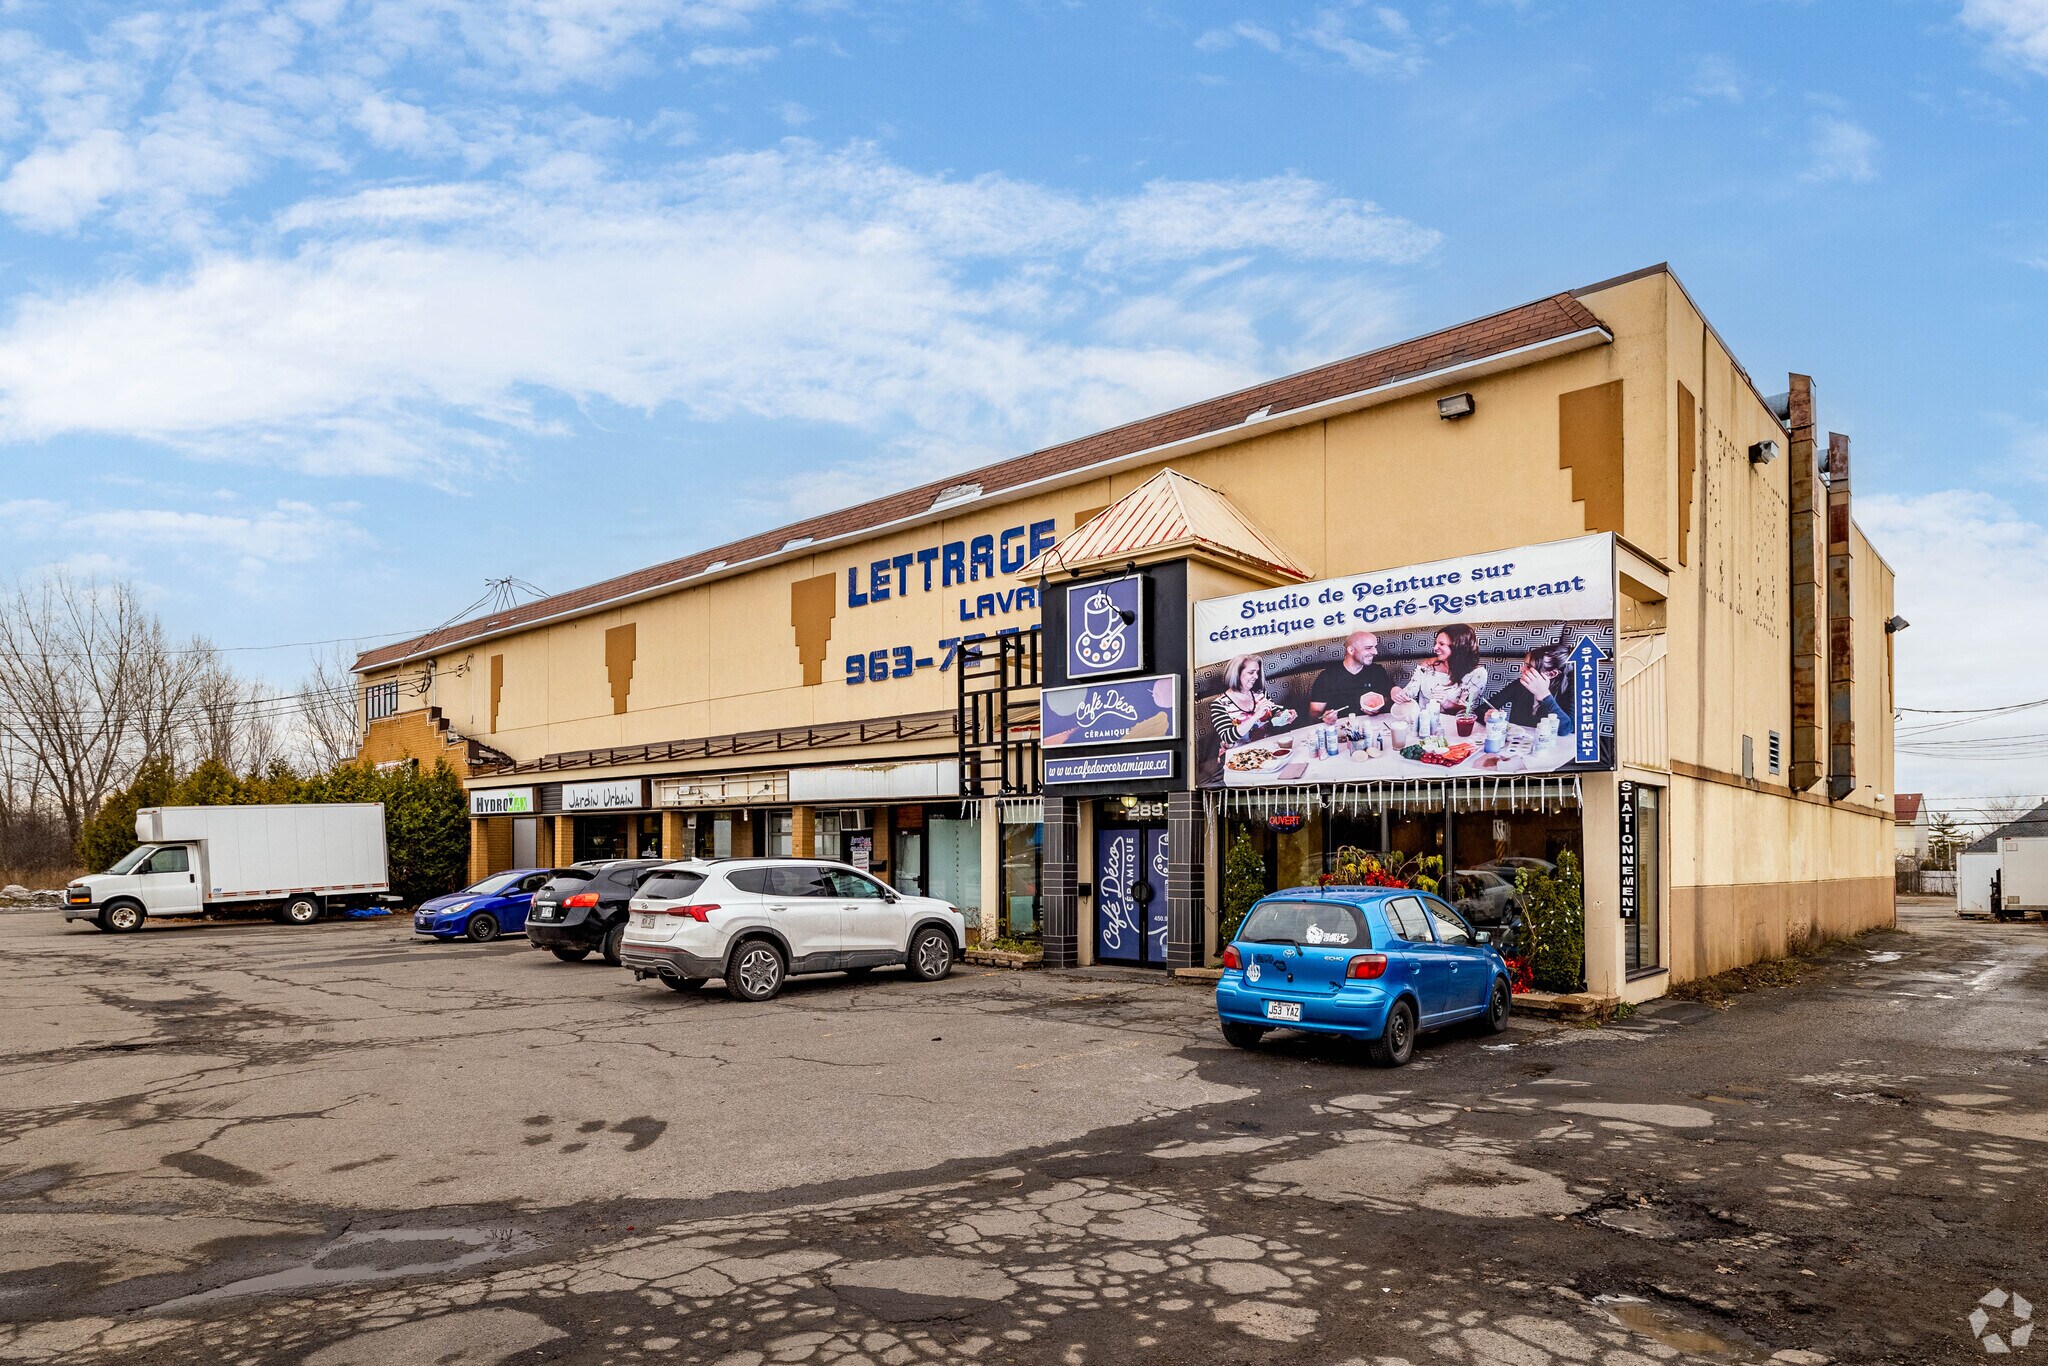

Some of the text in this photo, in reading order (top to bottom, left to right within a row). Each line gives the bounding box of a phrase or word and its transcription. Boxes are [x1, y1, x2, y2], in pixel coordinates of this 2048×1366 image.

[1209, 575, 1585, 642] céramique et Café-Restaurant
[1240, 562, 1514, 620] Studio de Peinture sur
[1076, 689, 1137, 720] Café Déco
[1580, 647, 1594, 756] STATIONNEMENT
[1084, 728, 1130, 738] CÉRAMIQUE
[1048, 756, 1168, 779] www.cafedecoceramique.ca
[1269, 815, 1301, 826] OUVERT
[1621, 781, 1635, 917] STATIONNEMENT
[1100, 842, 1128, 950] Café Déco
[1286, 1006, 1300, 1018] YAZ
